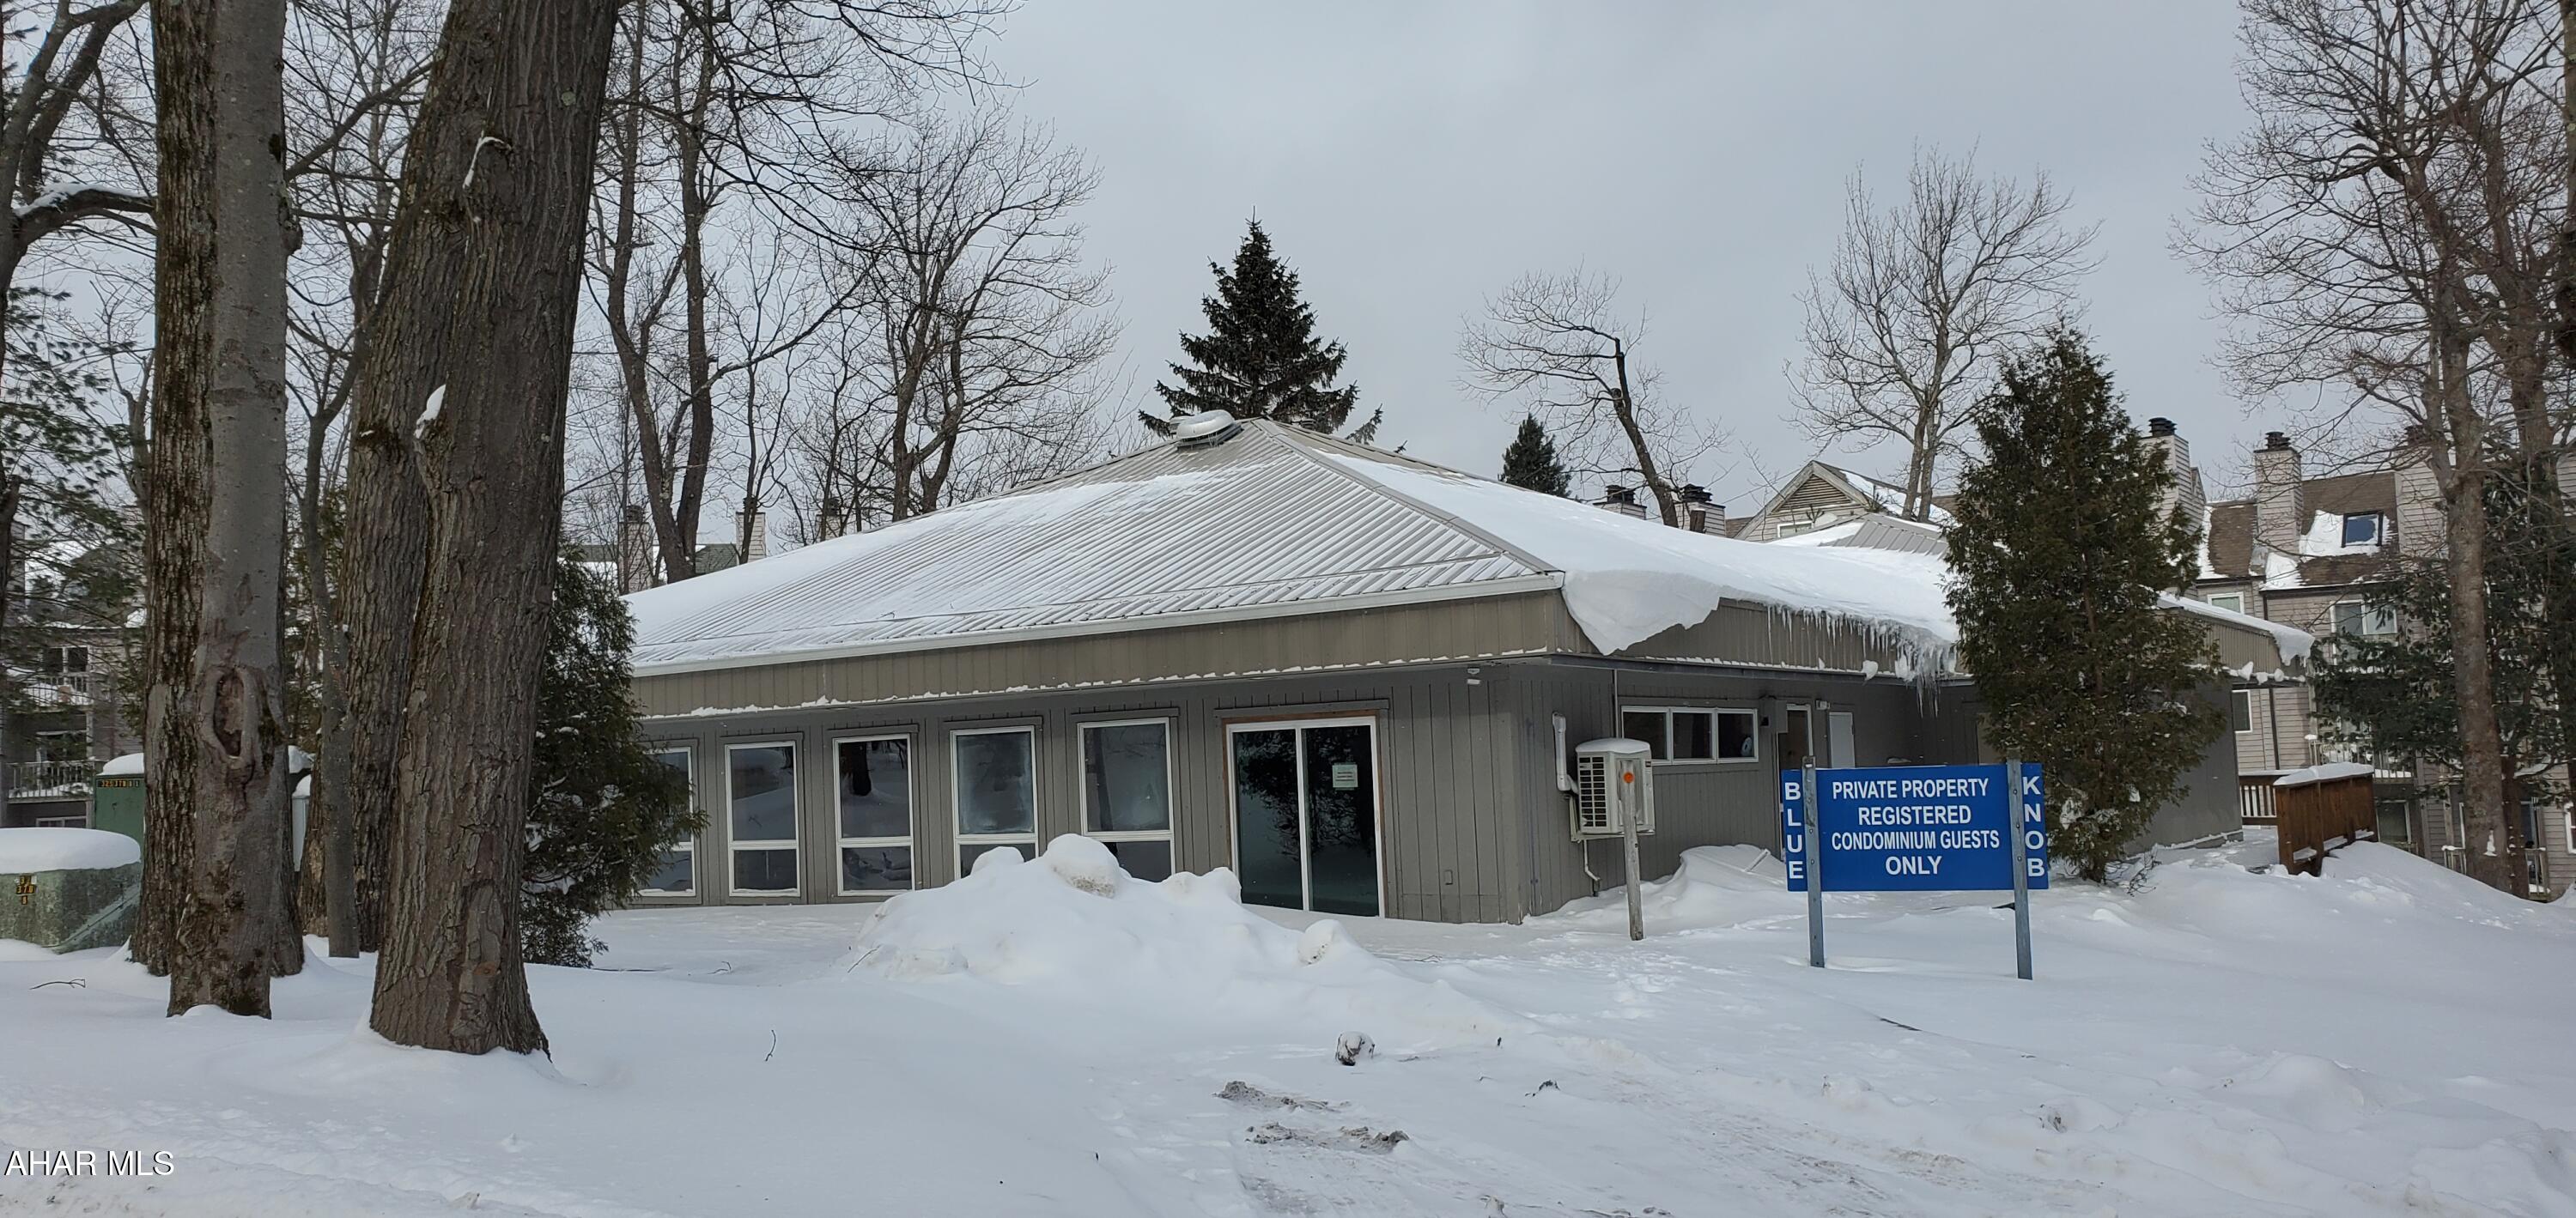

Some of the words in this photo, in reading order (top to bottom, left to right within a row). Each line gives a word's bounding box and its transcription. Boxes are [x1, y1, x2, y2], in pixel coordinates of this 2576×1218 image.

[1832, 780, 1898, 799] PRIVATE
[1901, 778, 1989, 798] PROPERTY
[1858, 805, 1971, 826] REGISTERED
[1784, 782, 1804, 879] BLUE
[2022, 776, 2045, 877] KNOB
[1832, 831, 1936, 851] CONDOMINIUM
[1940, 829, 2000, 850] GUESTS
[1885, 856, 1942, 876] ONLY
